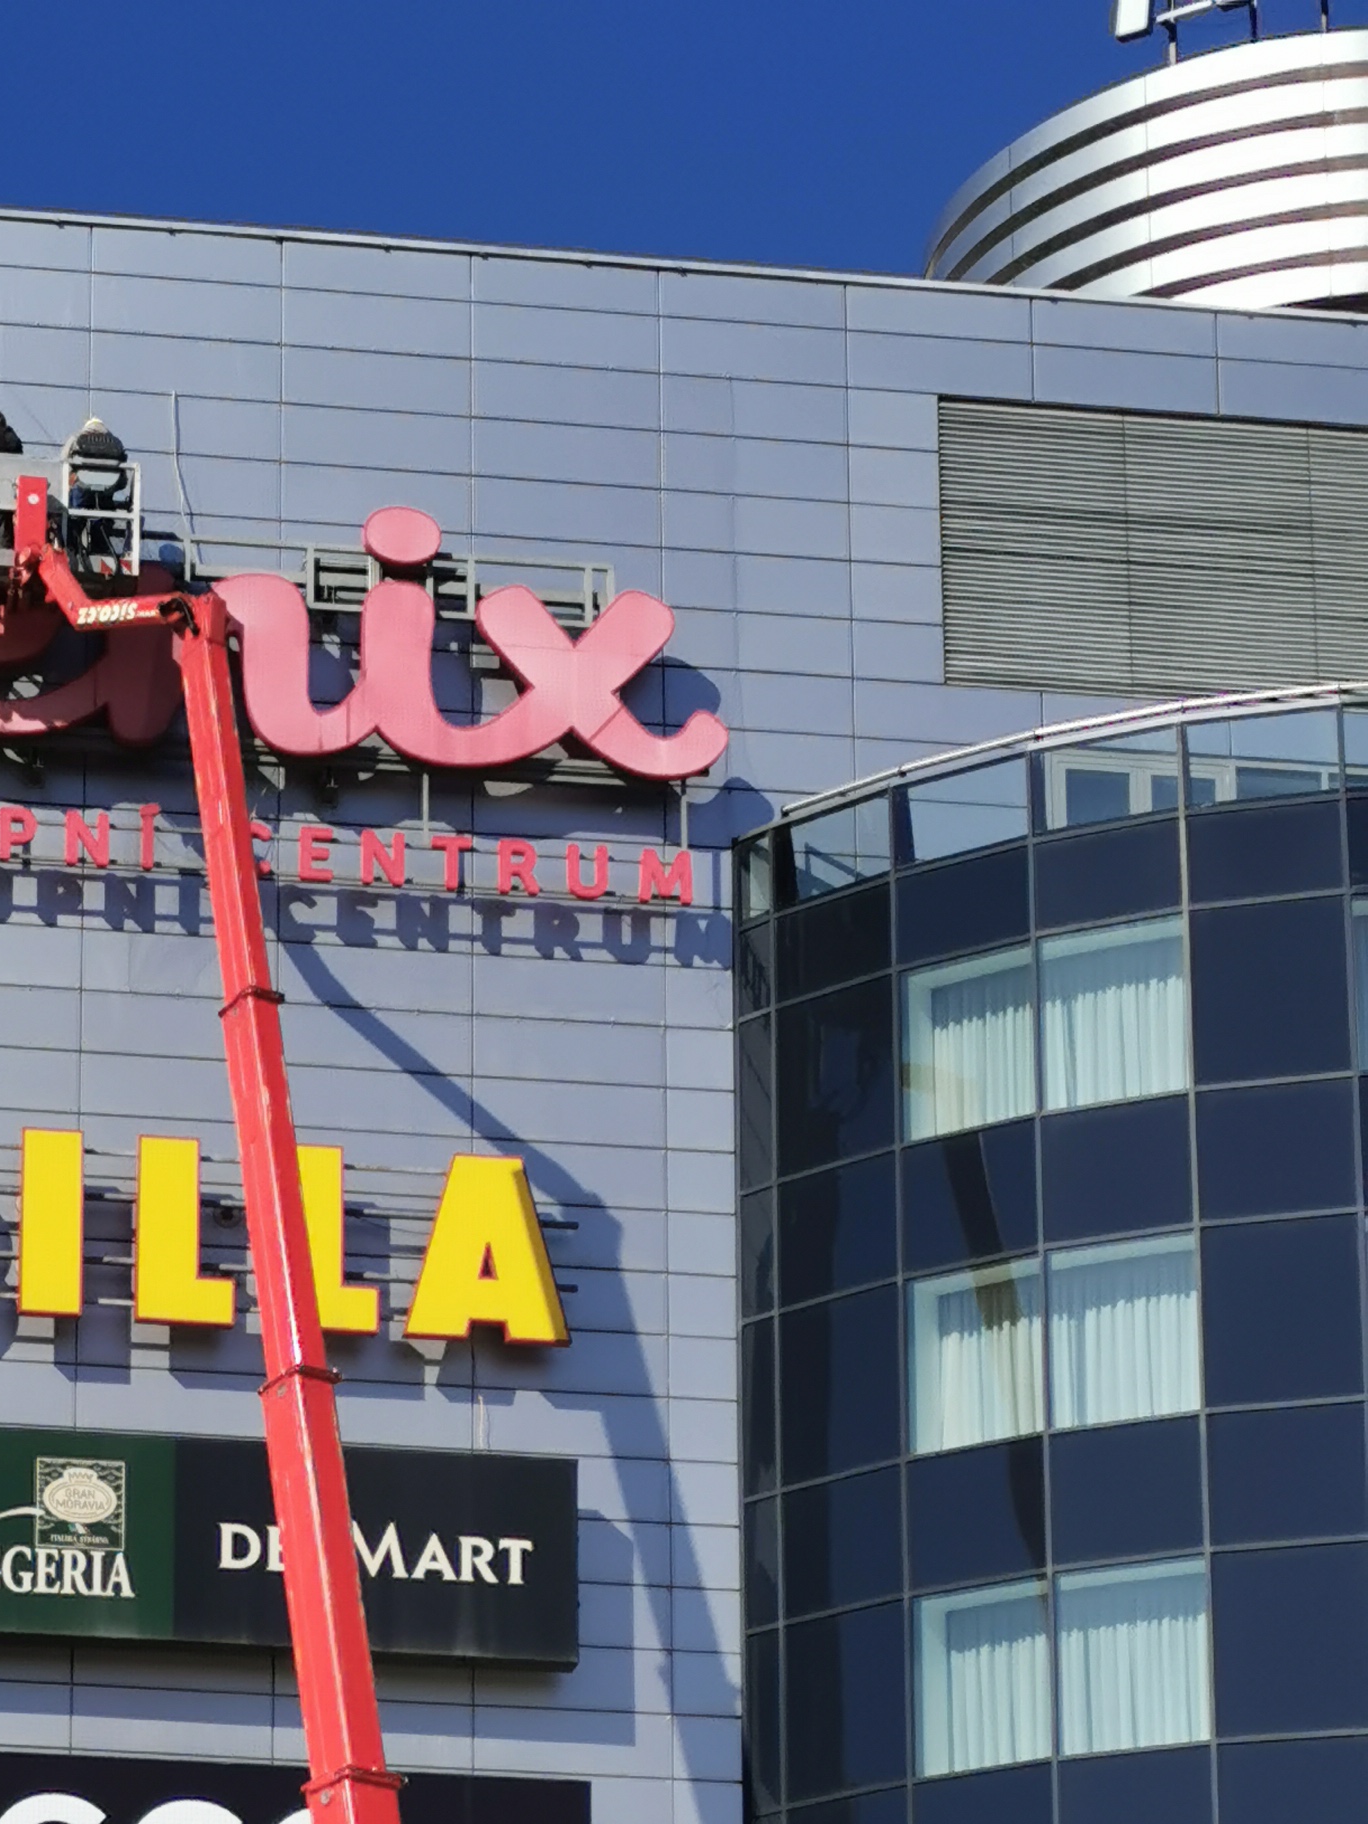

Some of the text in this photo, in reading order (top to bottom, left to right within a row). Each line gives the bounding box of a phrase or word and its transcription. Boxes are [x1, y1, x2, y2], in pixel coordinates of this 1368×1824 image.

[64, 1487, 95, 1499] GRAN
[55, 1499, 105, 1511] MORAVIA
[218, 1520, 533, 1586] DEMART
